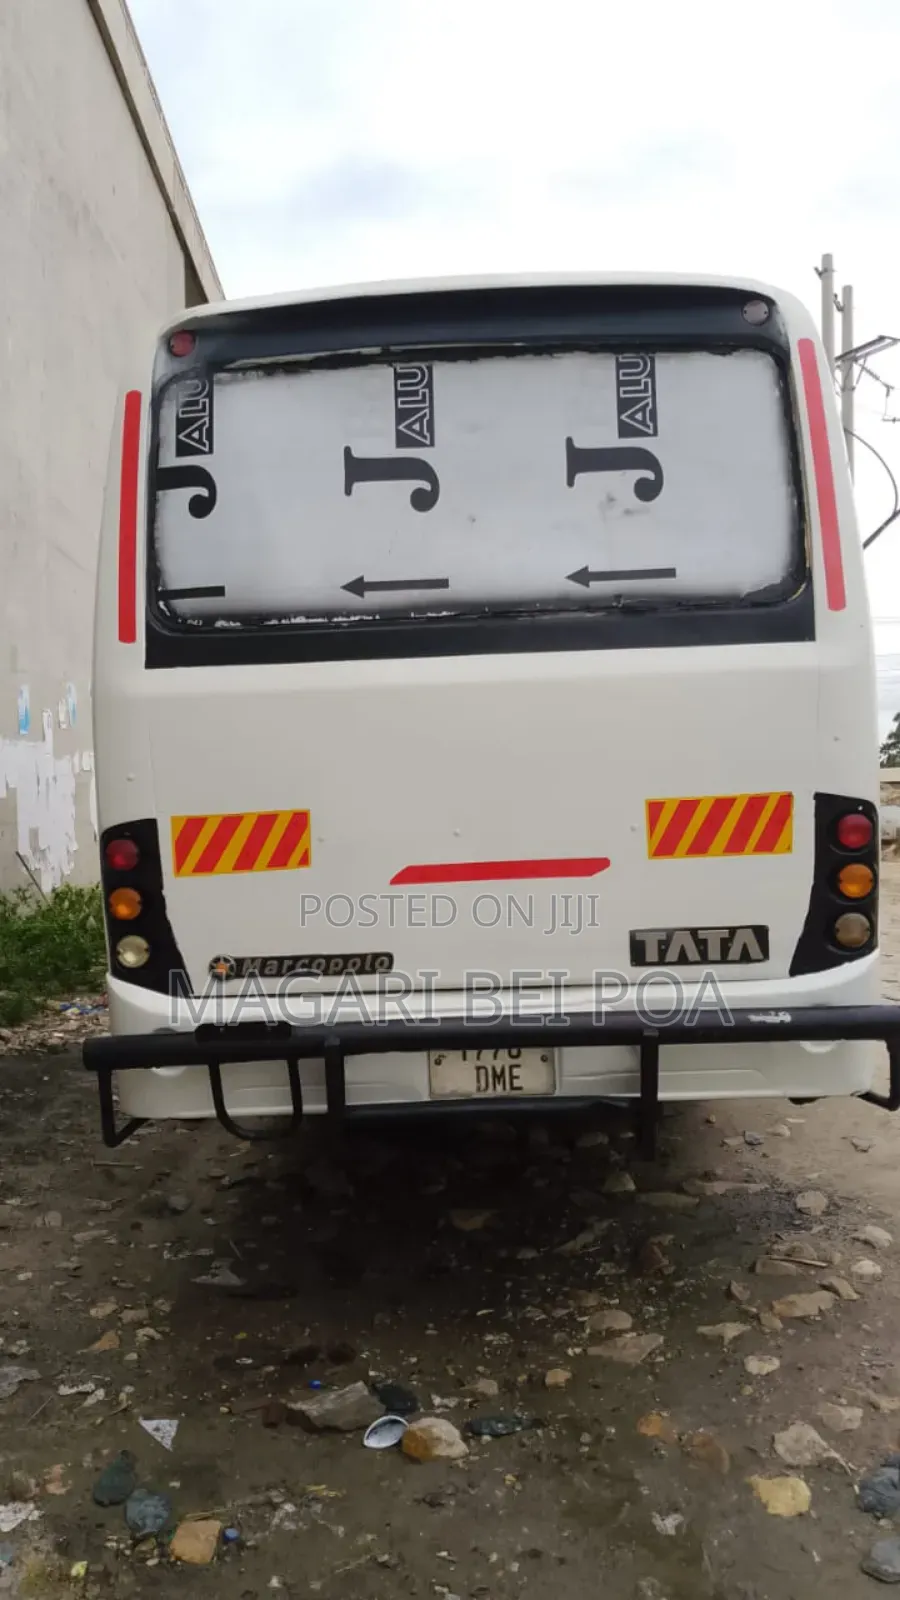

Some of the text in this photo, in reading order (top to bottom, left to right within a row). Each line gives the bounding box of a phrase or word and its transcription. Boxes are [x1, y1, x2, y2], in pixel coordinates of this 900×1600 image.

[343, 362, 441, 513] J ALU
[565, 353, 665, 503] J ALU
[635, 928, 764, 963] TATA
[240, 954, 391, 976] Marcopolo
[475, 1064, 524, 1092] DME
